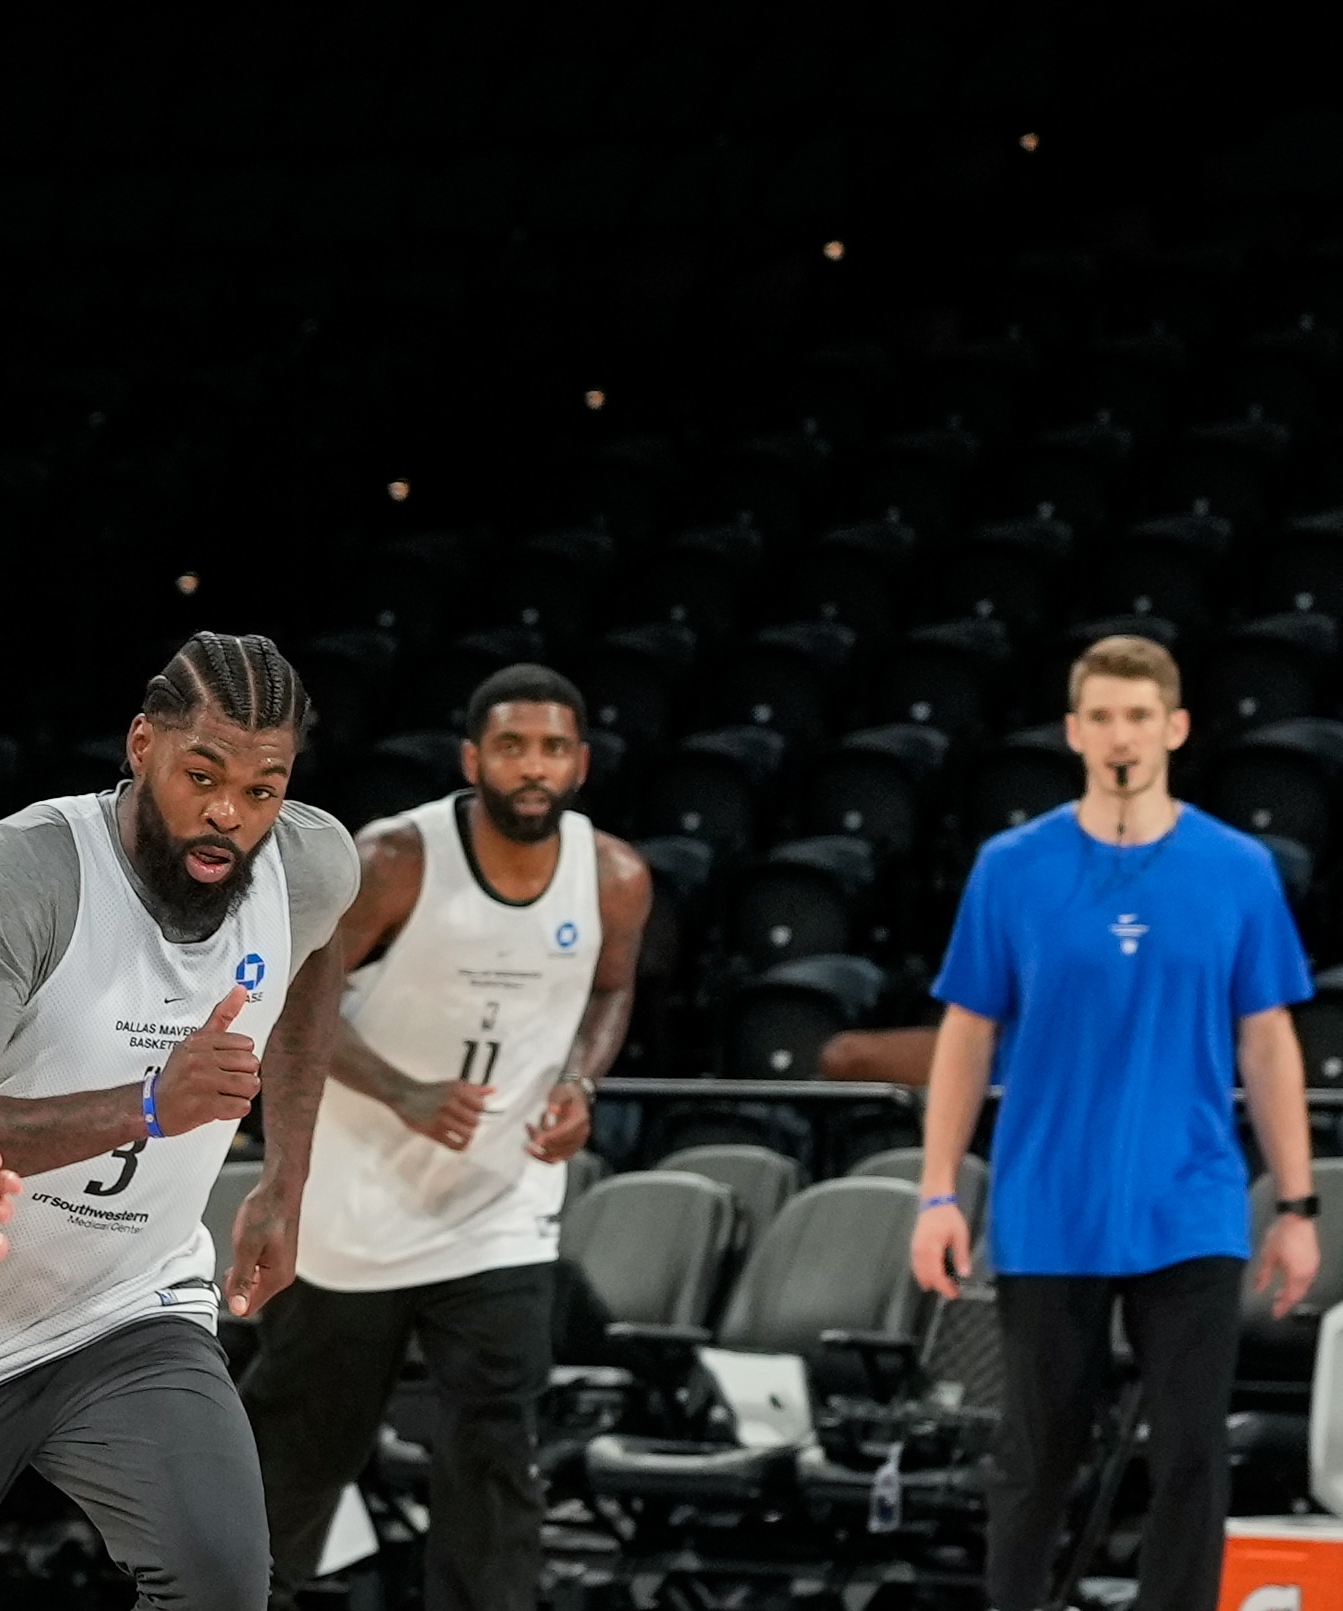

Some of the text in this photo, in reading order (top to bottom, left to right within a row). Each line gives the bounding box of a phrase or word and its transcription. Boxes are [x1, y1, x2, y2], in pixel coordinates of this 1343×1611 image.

[116, 1020, 156, 1034] DALLAS
[130, 1037, 180, 1050] BASKET
[459, 1040, 501, 1085] 11
[83, 1137, 148, 1196] 3
